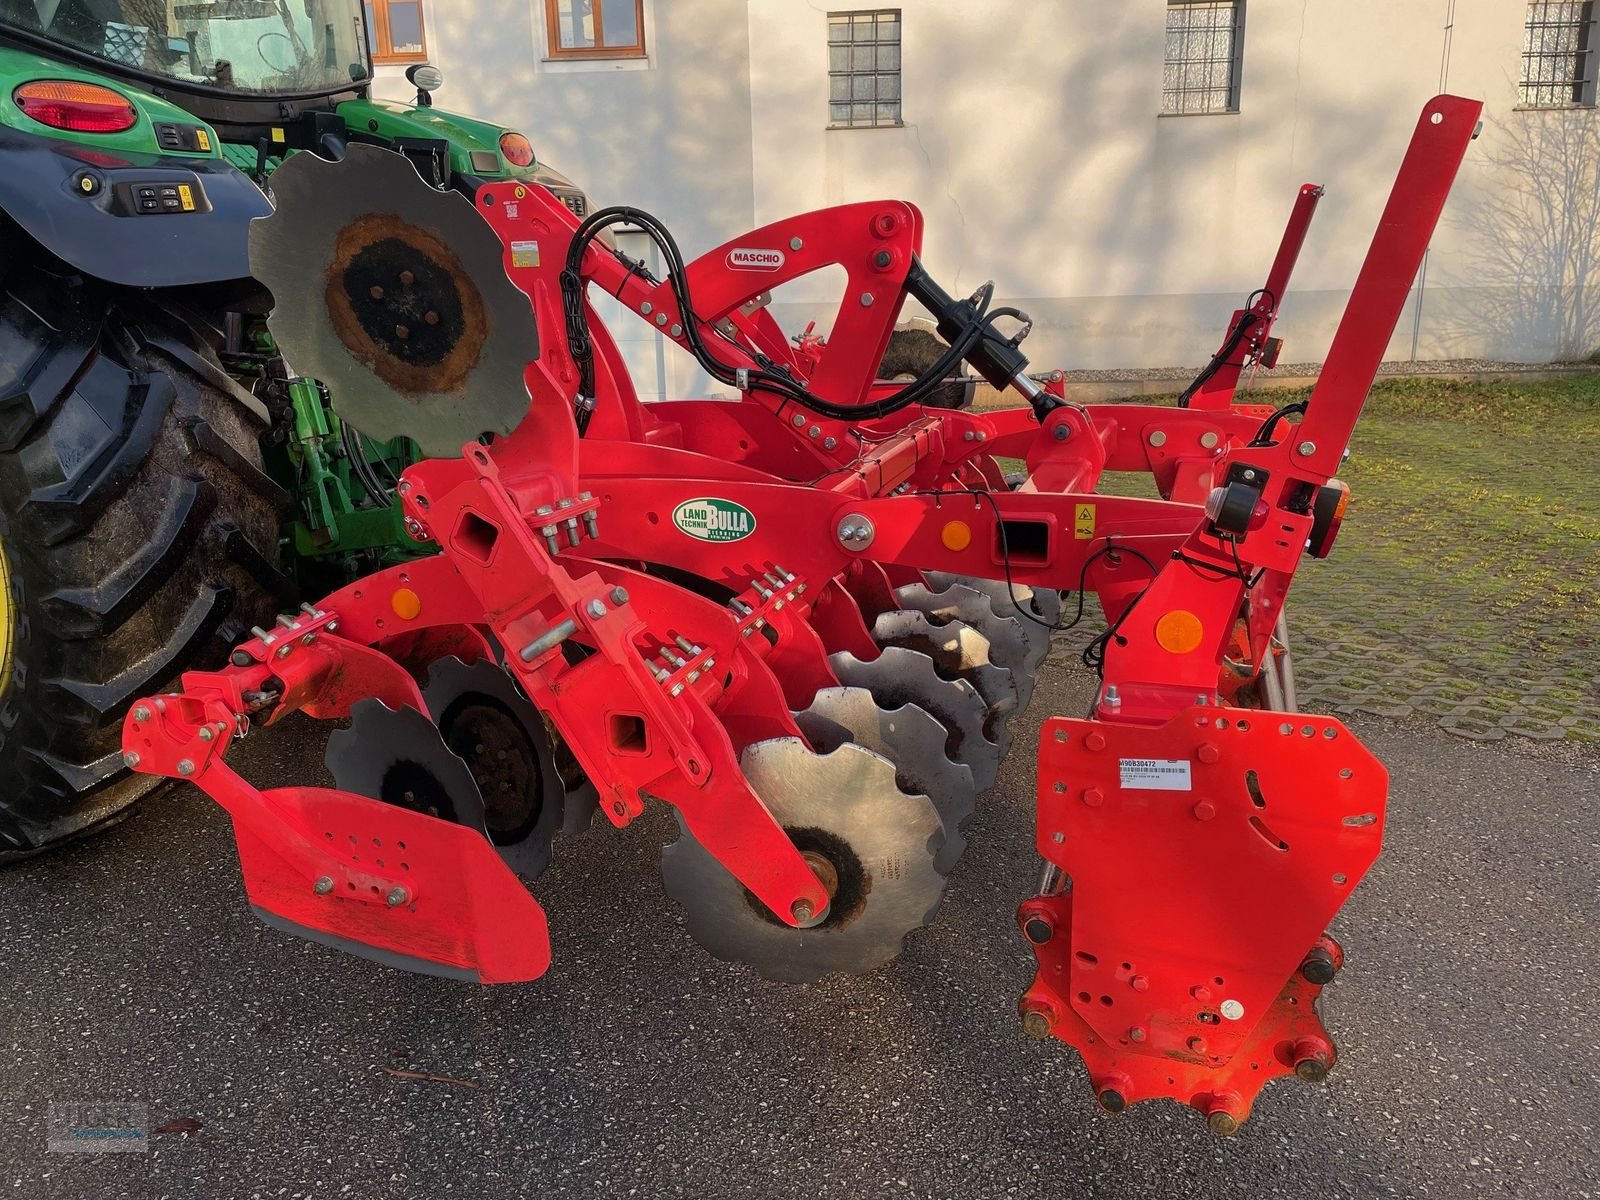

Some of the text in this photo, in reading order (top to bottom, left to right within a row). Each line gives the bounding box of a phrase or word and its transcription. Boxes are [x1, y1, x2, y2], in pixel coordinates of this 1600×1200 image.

[734, 253, 780, 263] MASCHIO
[683, 508, 707, 520] LAND
[707, 505, 748, 532] BULLA
[681, 519, 707, 529] TECHNIK
